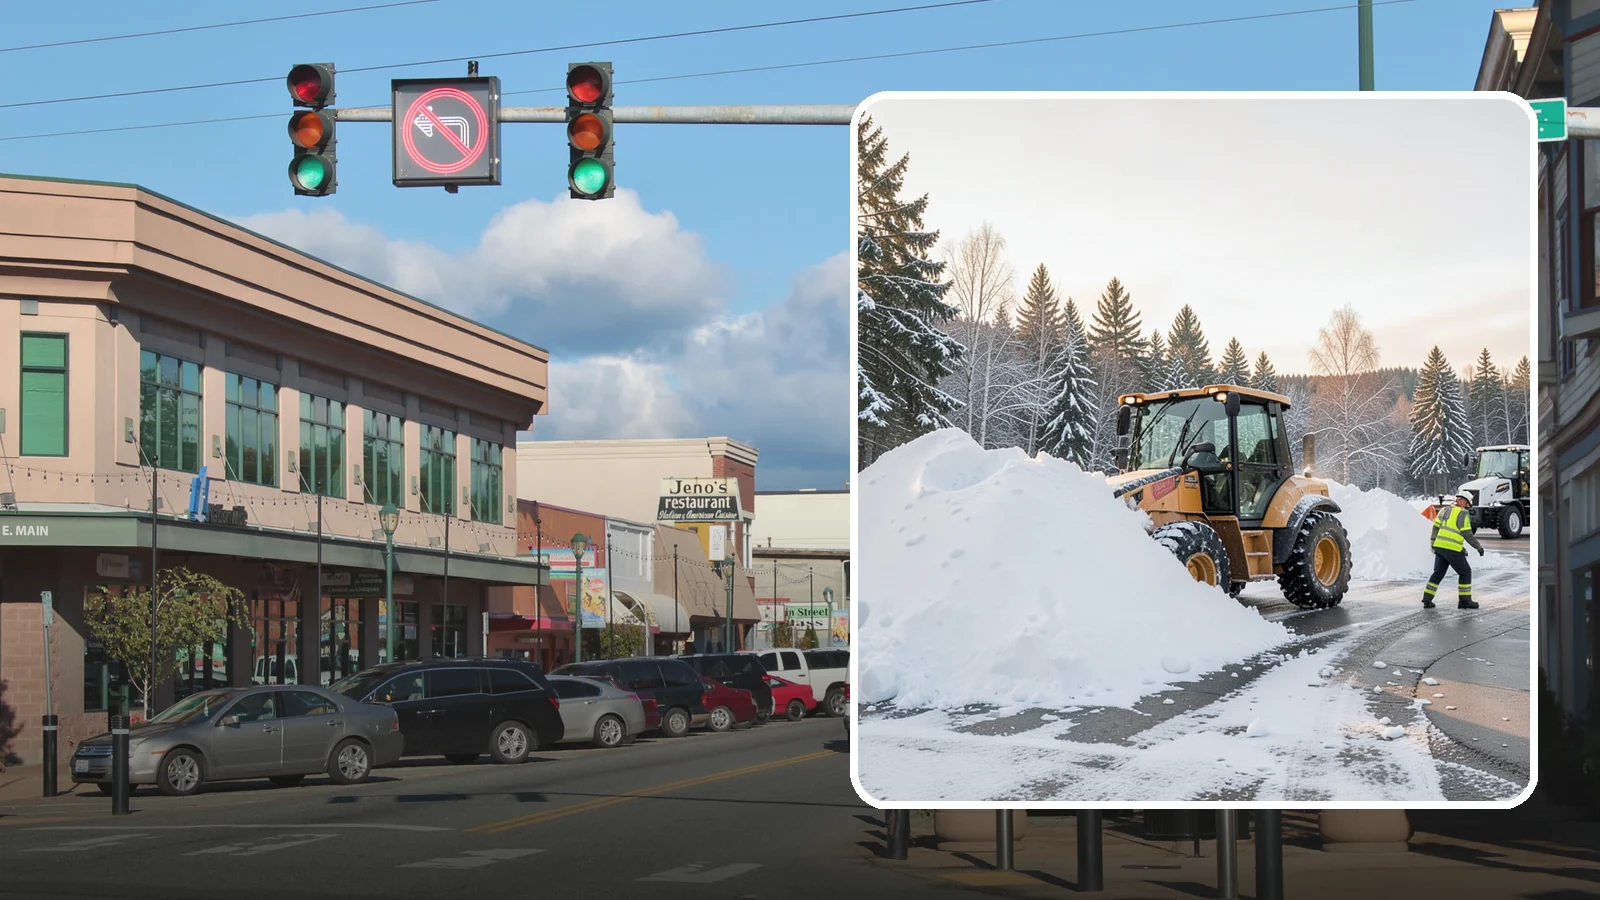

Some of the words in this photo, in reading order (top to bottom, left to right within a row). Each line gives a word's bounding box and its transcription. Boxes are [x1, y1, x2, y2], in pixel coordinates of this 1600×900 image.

[670, 480, 727, 494] Jeno's
[665, 497, 730, 509] restaurant
[659, 510, 681, 519] Italian
[686, 510, 714, 519] American
[715, 510, 737, 519] Cuisine
[2, 525, 12, 536] E.
[16, 525, 48, 536] MAIN
[797, 608, 828, 616] Street
